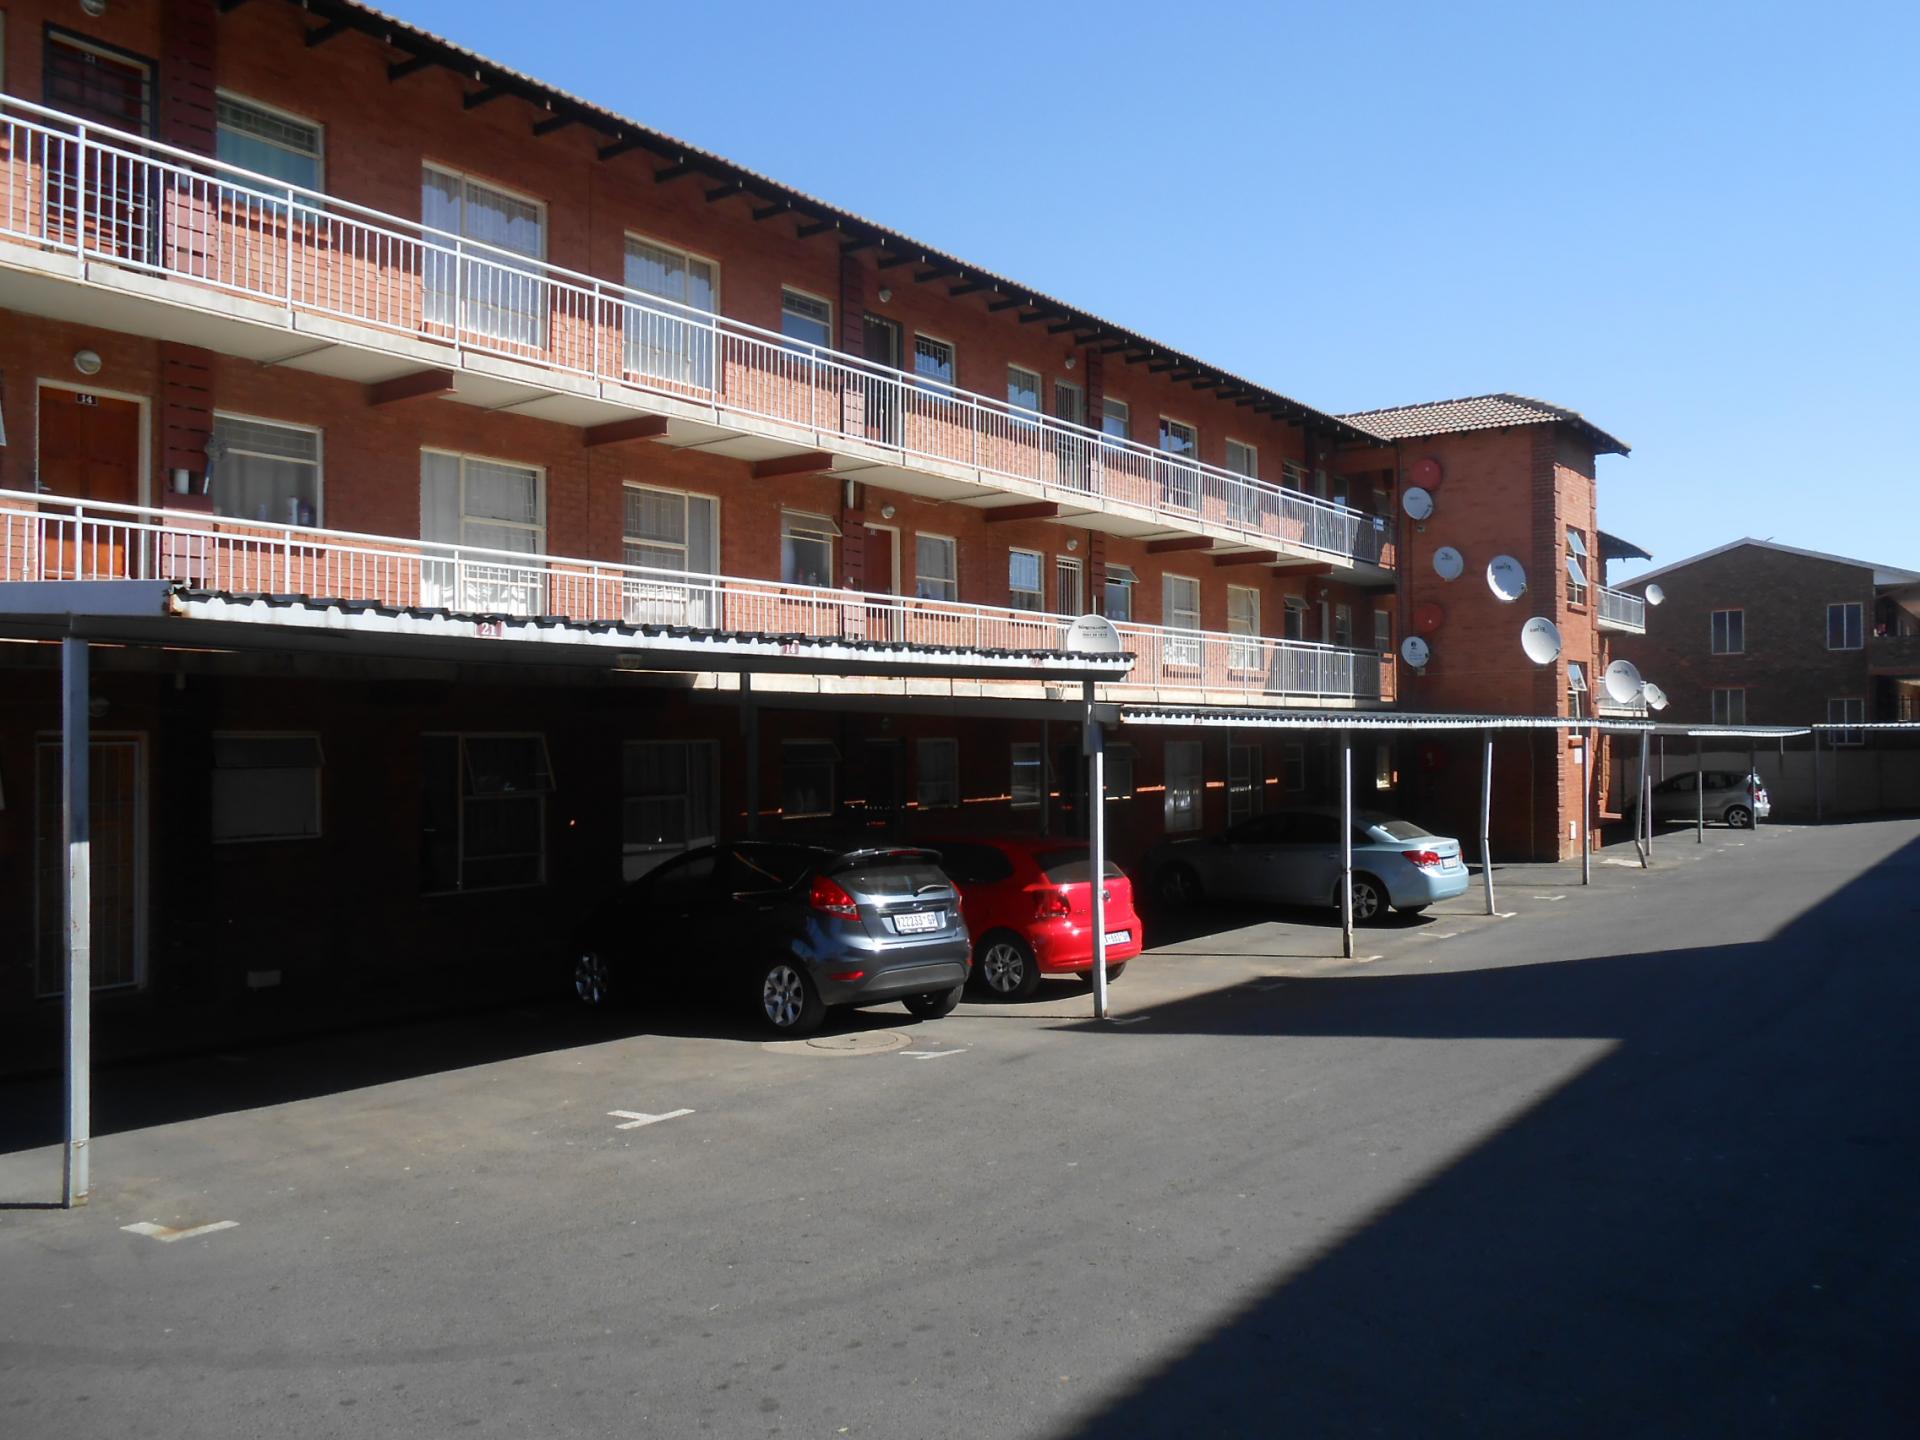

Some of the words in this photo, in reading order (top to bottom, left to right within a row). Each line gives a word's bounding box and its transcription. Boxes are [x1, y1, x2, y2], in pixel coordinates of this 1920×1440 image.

[82, 394, 92, 404] 14
[481, 622, 496, 636] 21
[785, 644, 796, 654] 14
